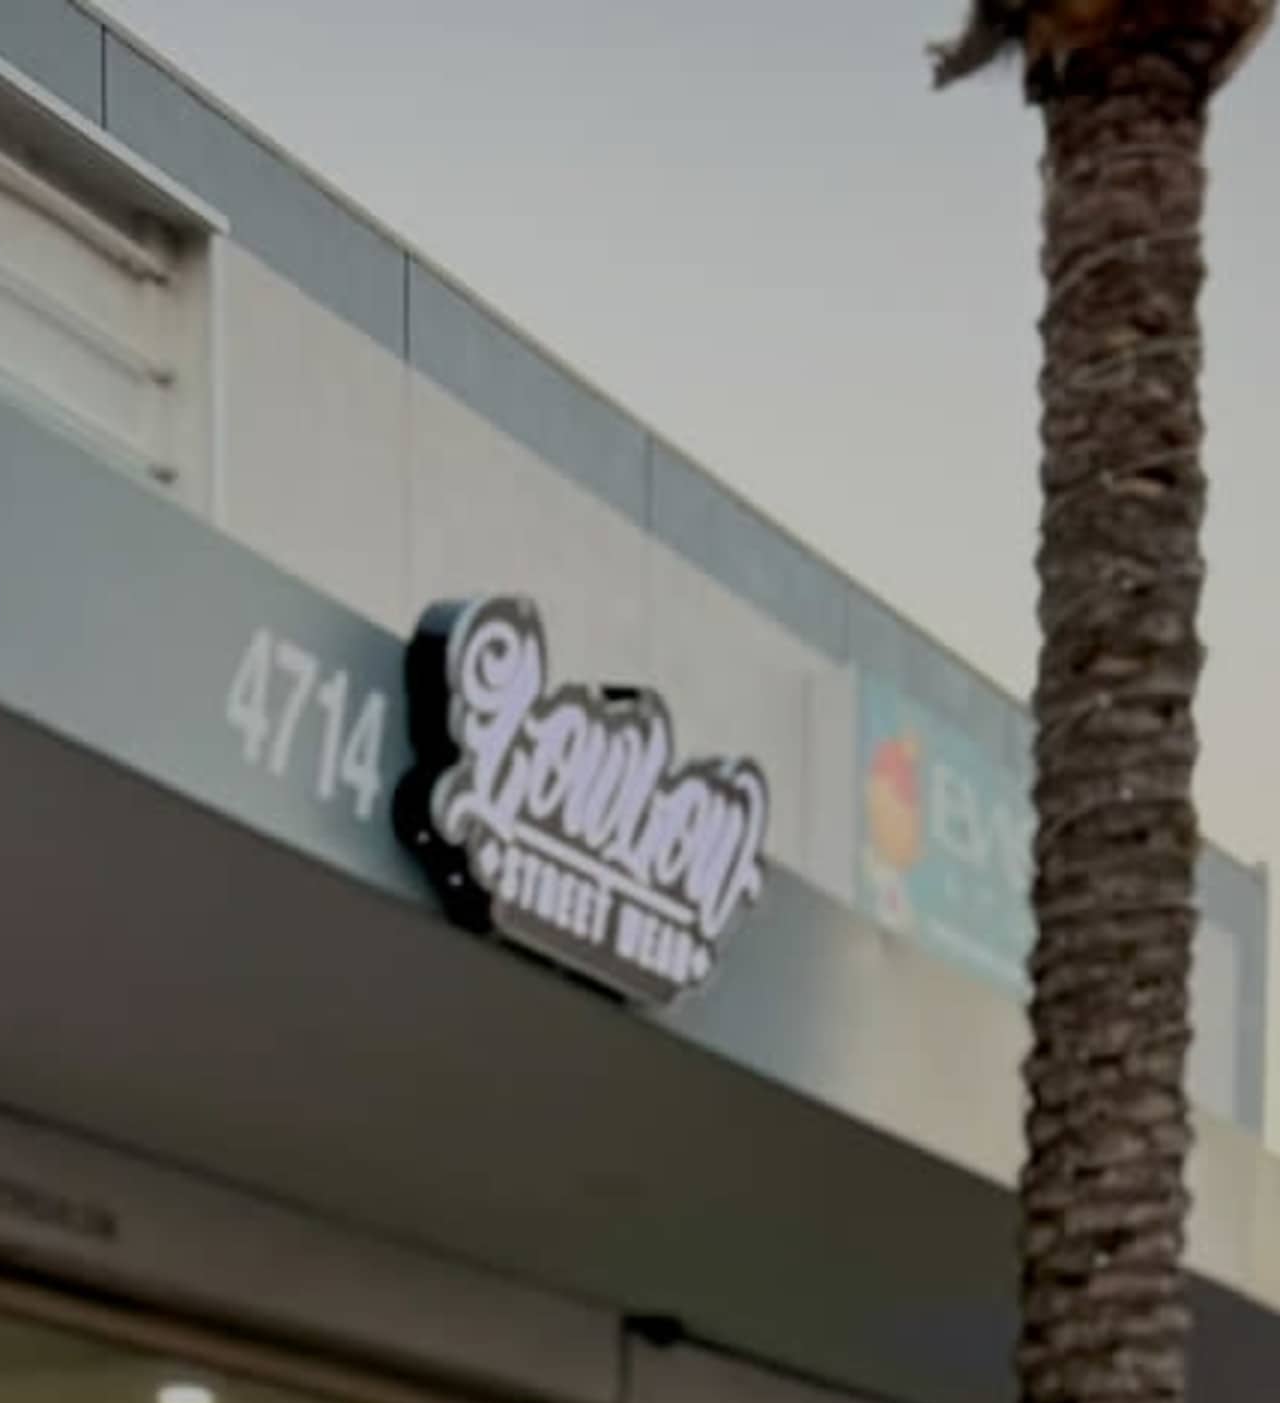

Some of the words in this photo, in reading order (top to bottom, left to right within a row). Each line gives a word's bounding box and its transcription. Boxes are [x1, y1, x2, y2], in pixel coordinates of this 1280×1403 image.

[226, 627, 384, 821] 4714
[500, 848, 616, 944] STREET
[616, 903, 691, 984] WEAR
